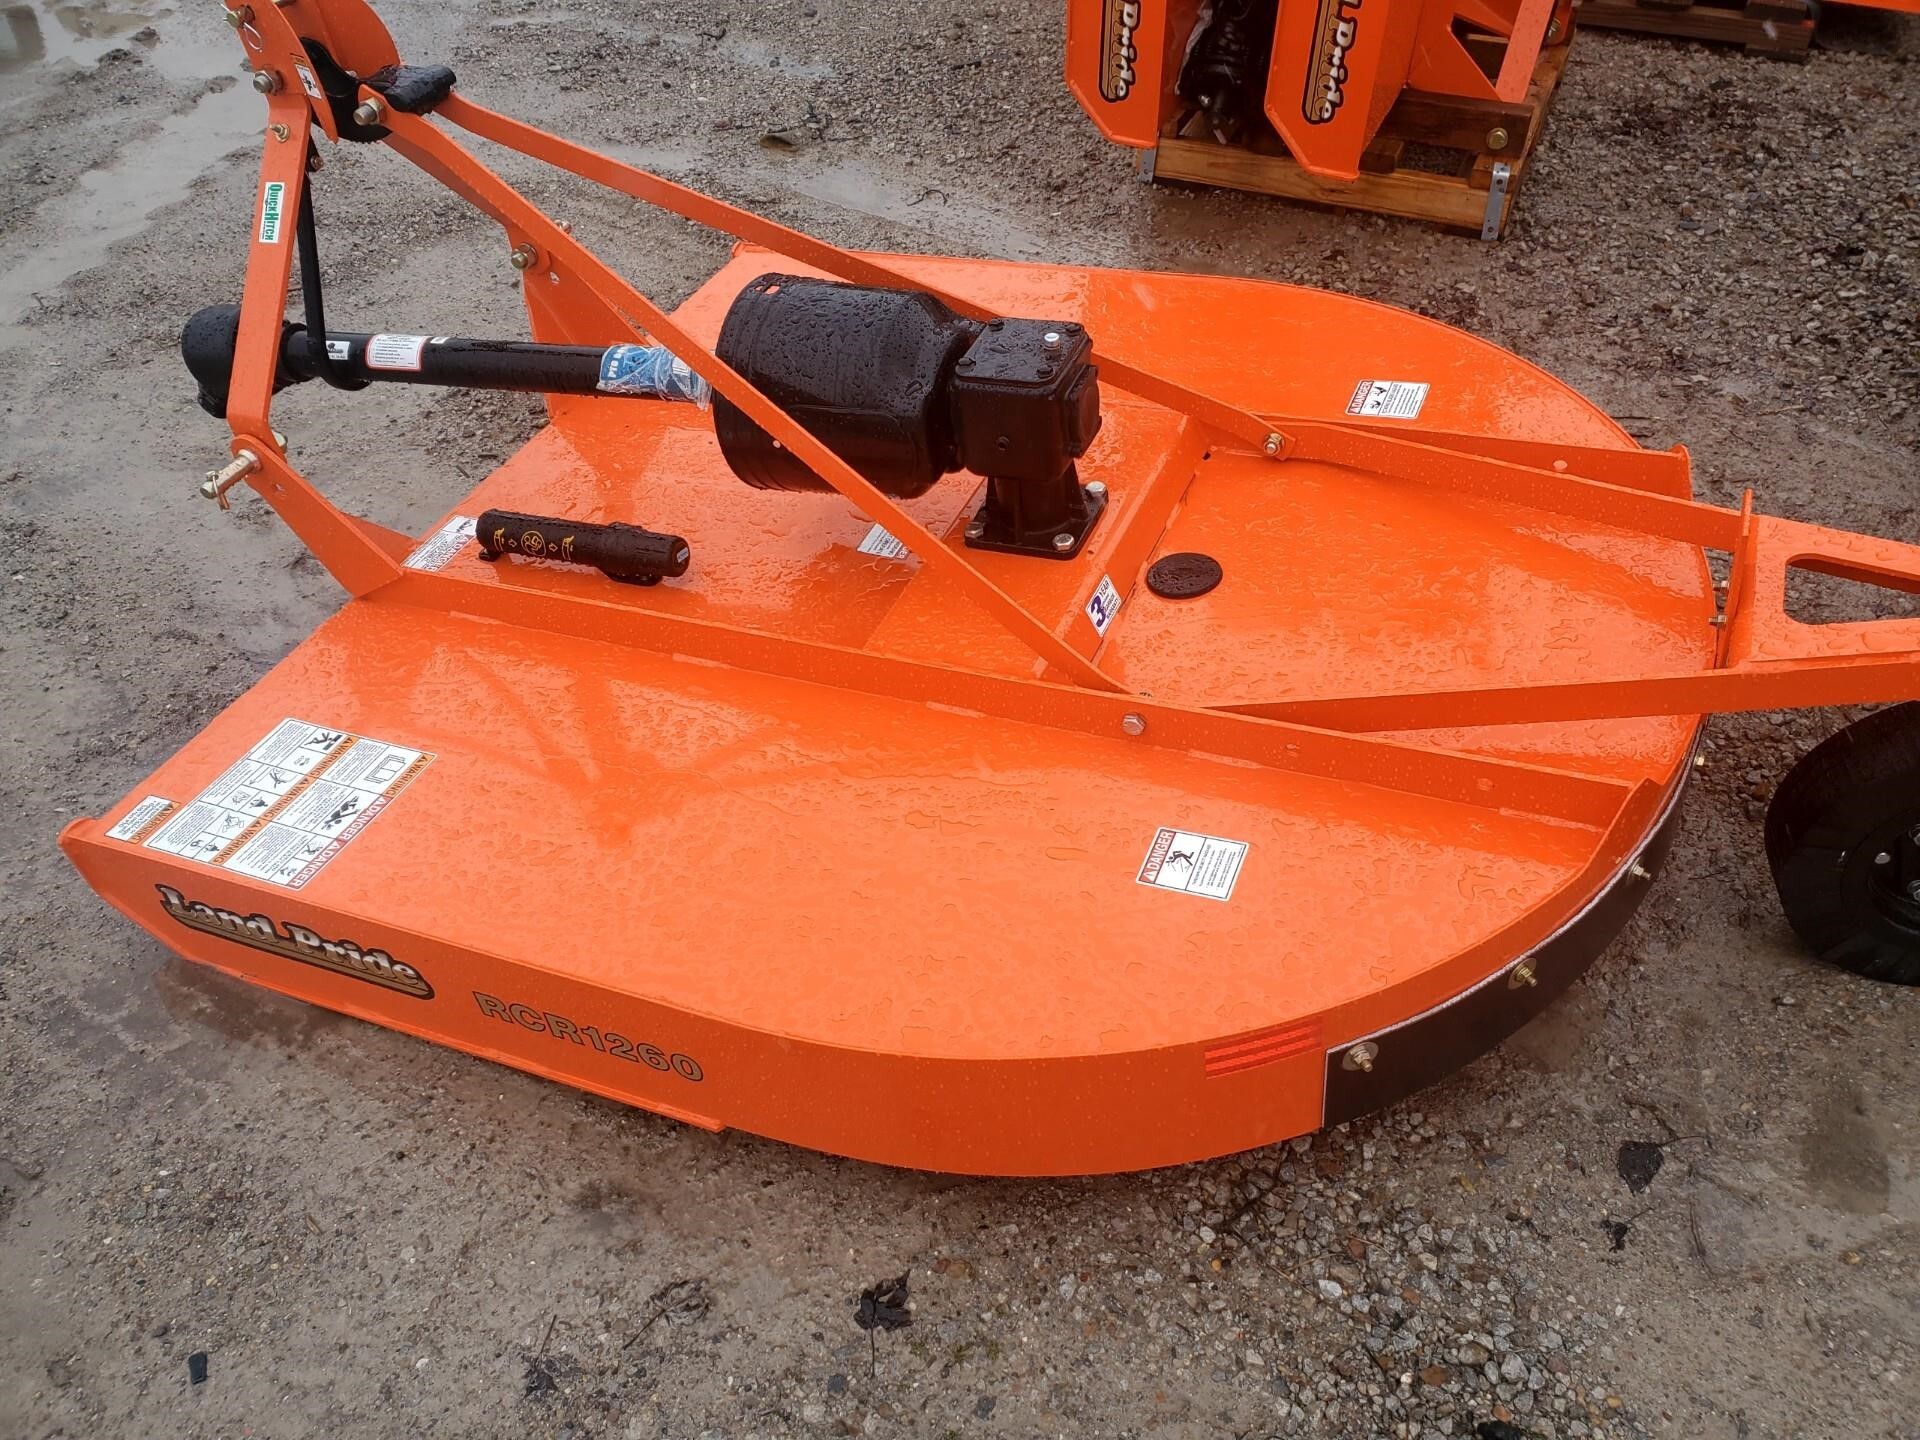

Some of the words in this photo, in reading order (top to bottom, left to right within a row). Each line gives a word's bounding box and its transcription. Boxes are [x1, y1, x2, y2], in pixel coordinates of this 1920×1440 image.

[1313, 14, 1355, 120] Pride
[1091, 595, 1106, 627] 3
[311, 742, 350, 778] WARNING
[385, 760, 424, 798] WARNING
[264, 783, 307, 820] WARNING
[341, 802, 383, 840] DANGER
[213, 826, 257, 864] WARNING
[1150, 831, 1174, 872] DANGER
[292, 849, 335, 887] DANGER
[158, 886, 281, 944] Land
[284, 921, 420, 985] Pride
[472, 990, 704, 1082] RCR1260
